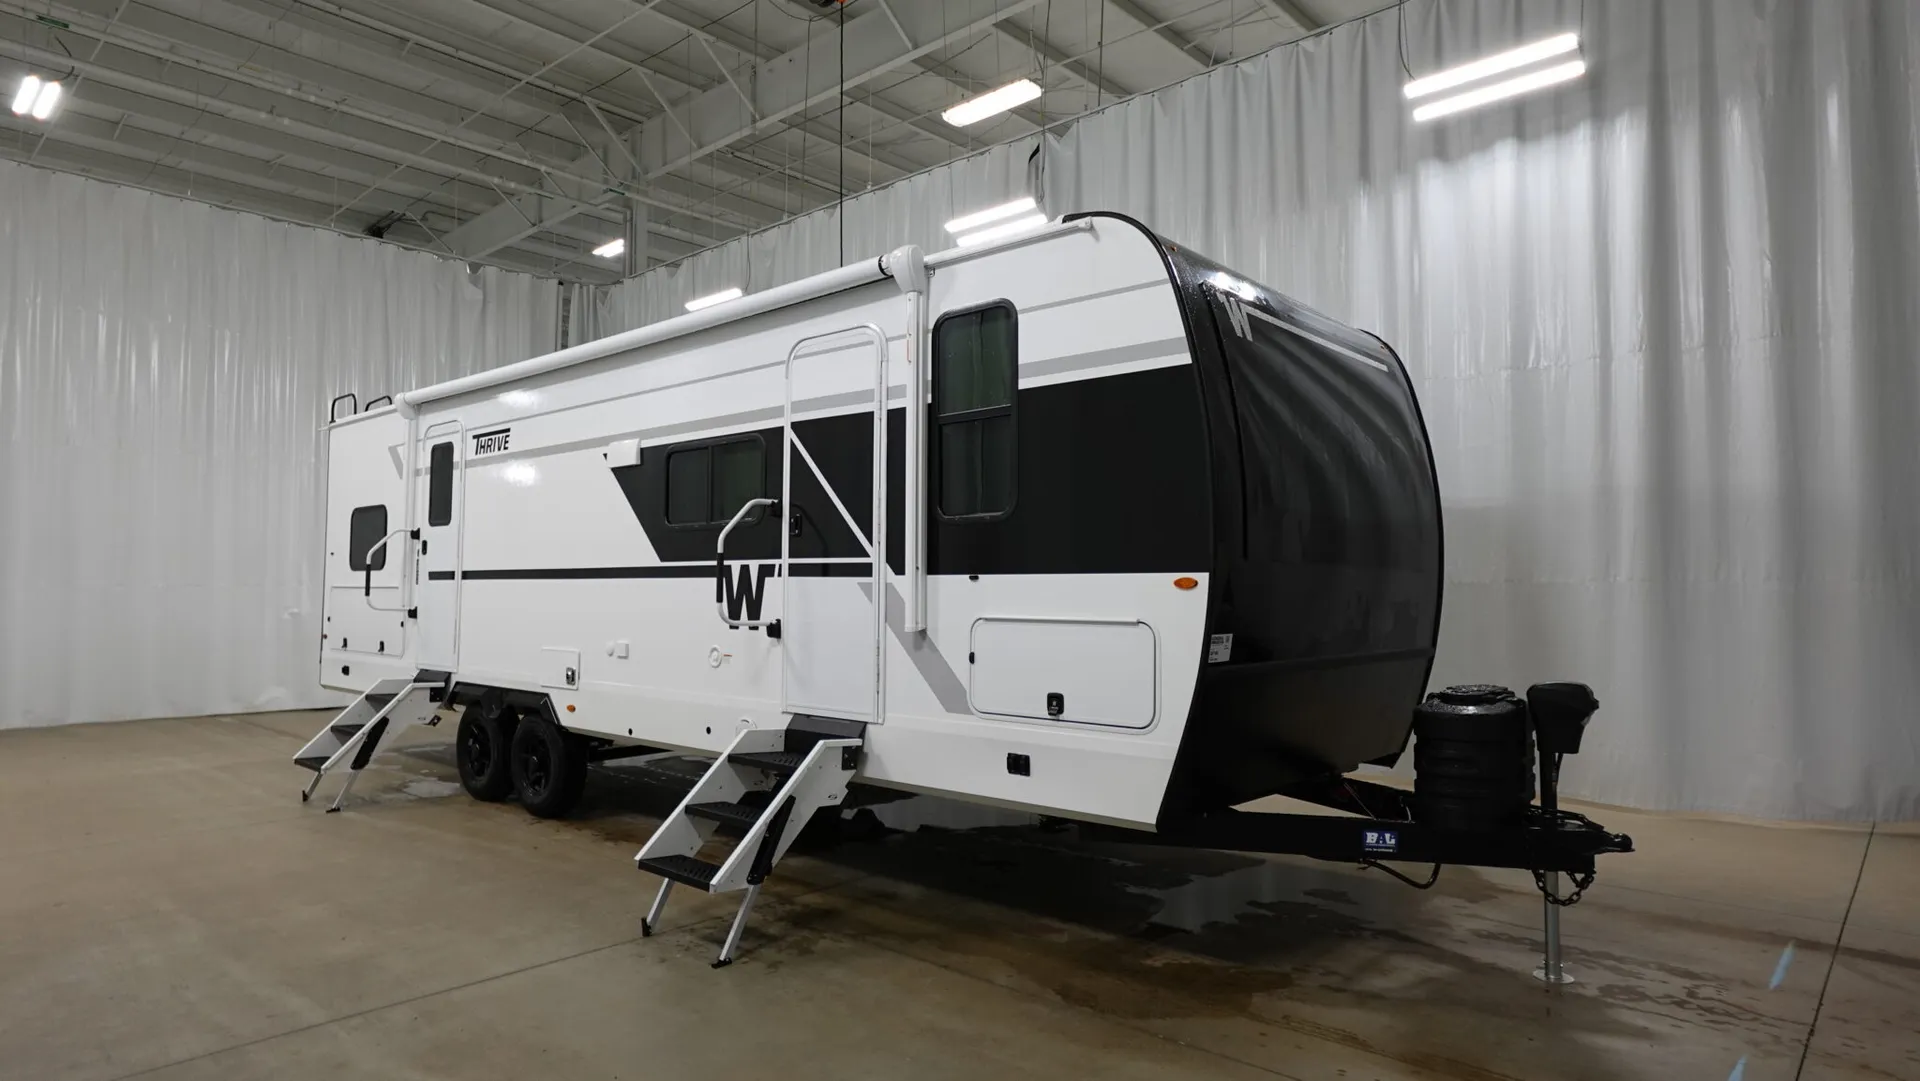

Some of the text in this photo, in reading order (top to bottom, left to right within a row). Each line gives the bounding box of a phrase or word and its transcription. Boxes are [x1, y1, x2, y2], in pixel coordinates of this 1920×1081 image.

[1216, 291, 1253, 342] W
[472, 427, 511, 456] THRIVE
[723, 564, 777, 631] W
